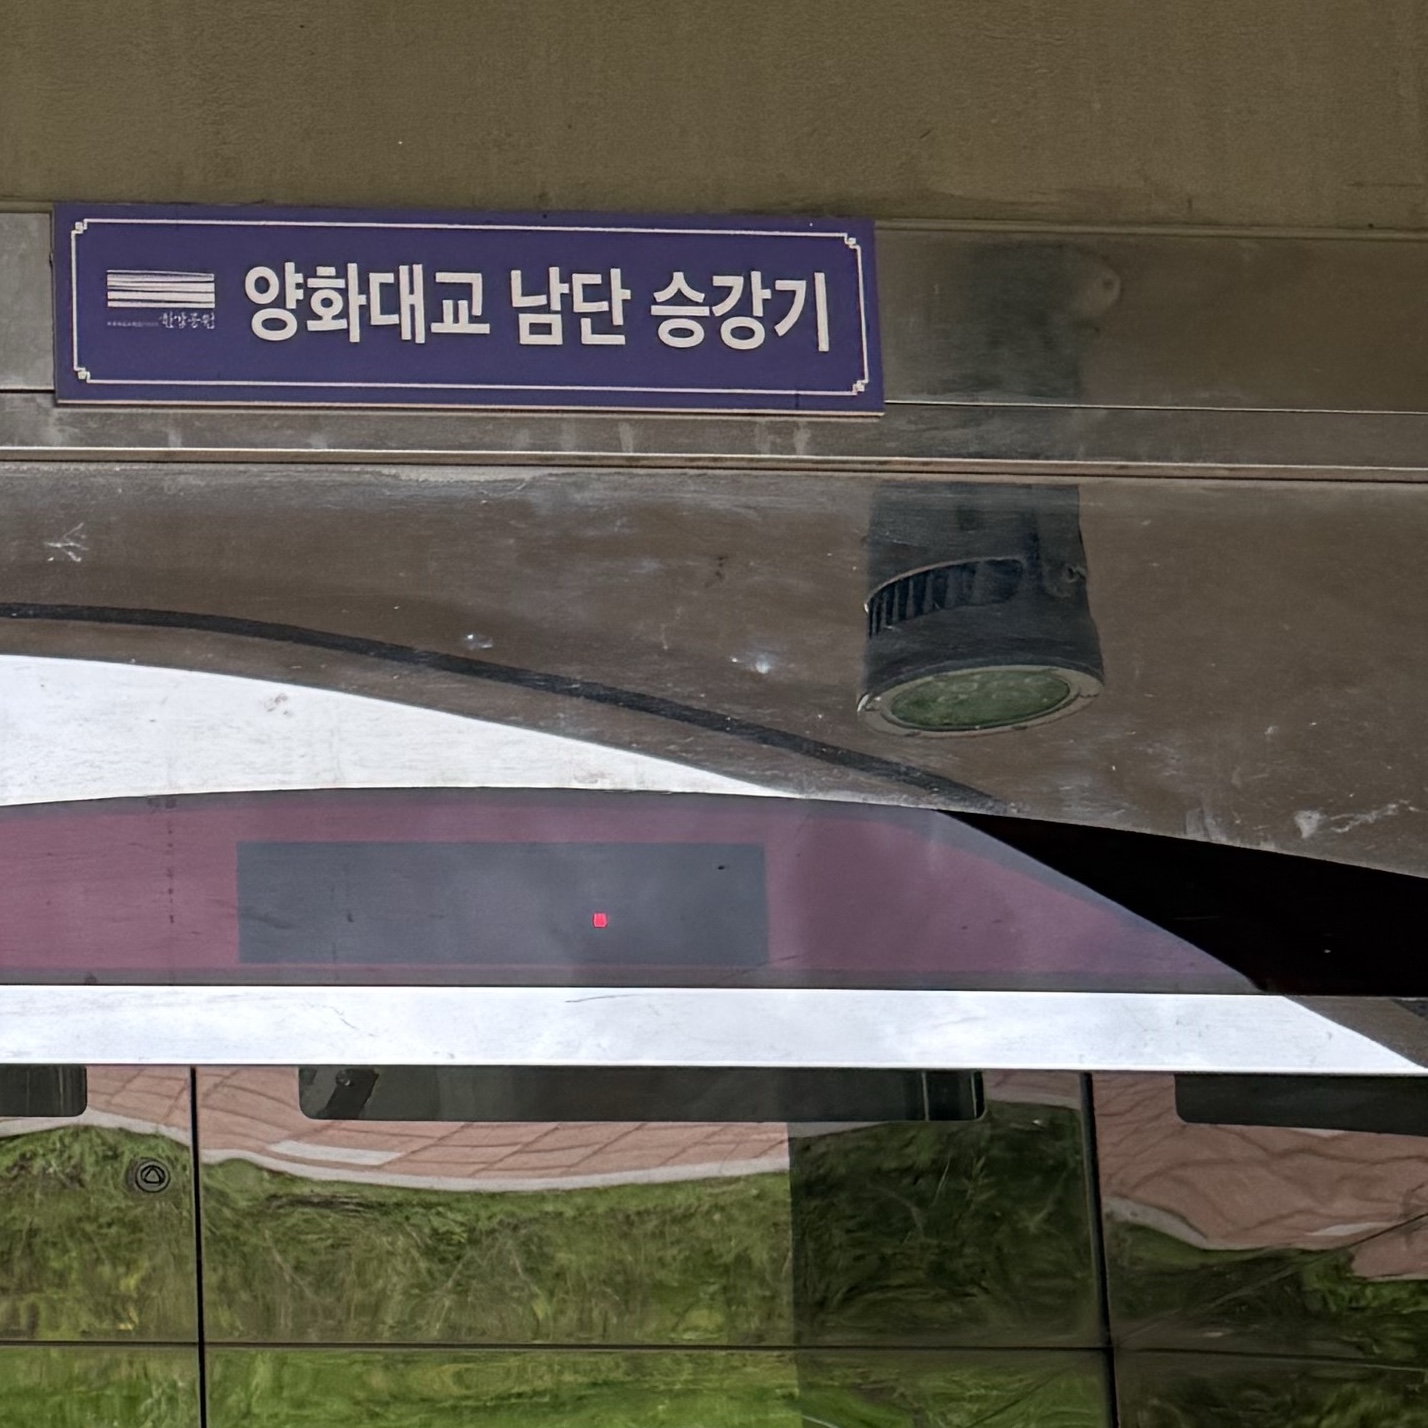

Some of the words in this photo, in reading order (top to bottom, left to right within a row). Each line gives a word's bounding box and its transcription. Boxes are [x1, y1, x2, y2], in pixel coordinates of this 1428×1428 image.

[244, 262, 490, 345] 양화대교
[509, 266, 632, 348] 남단
[650, 270, 830, 352] 승강기
